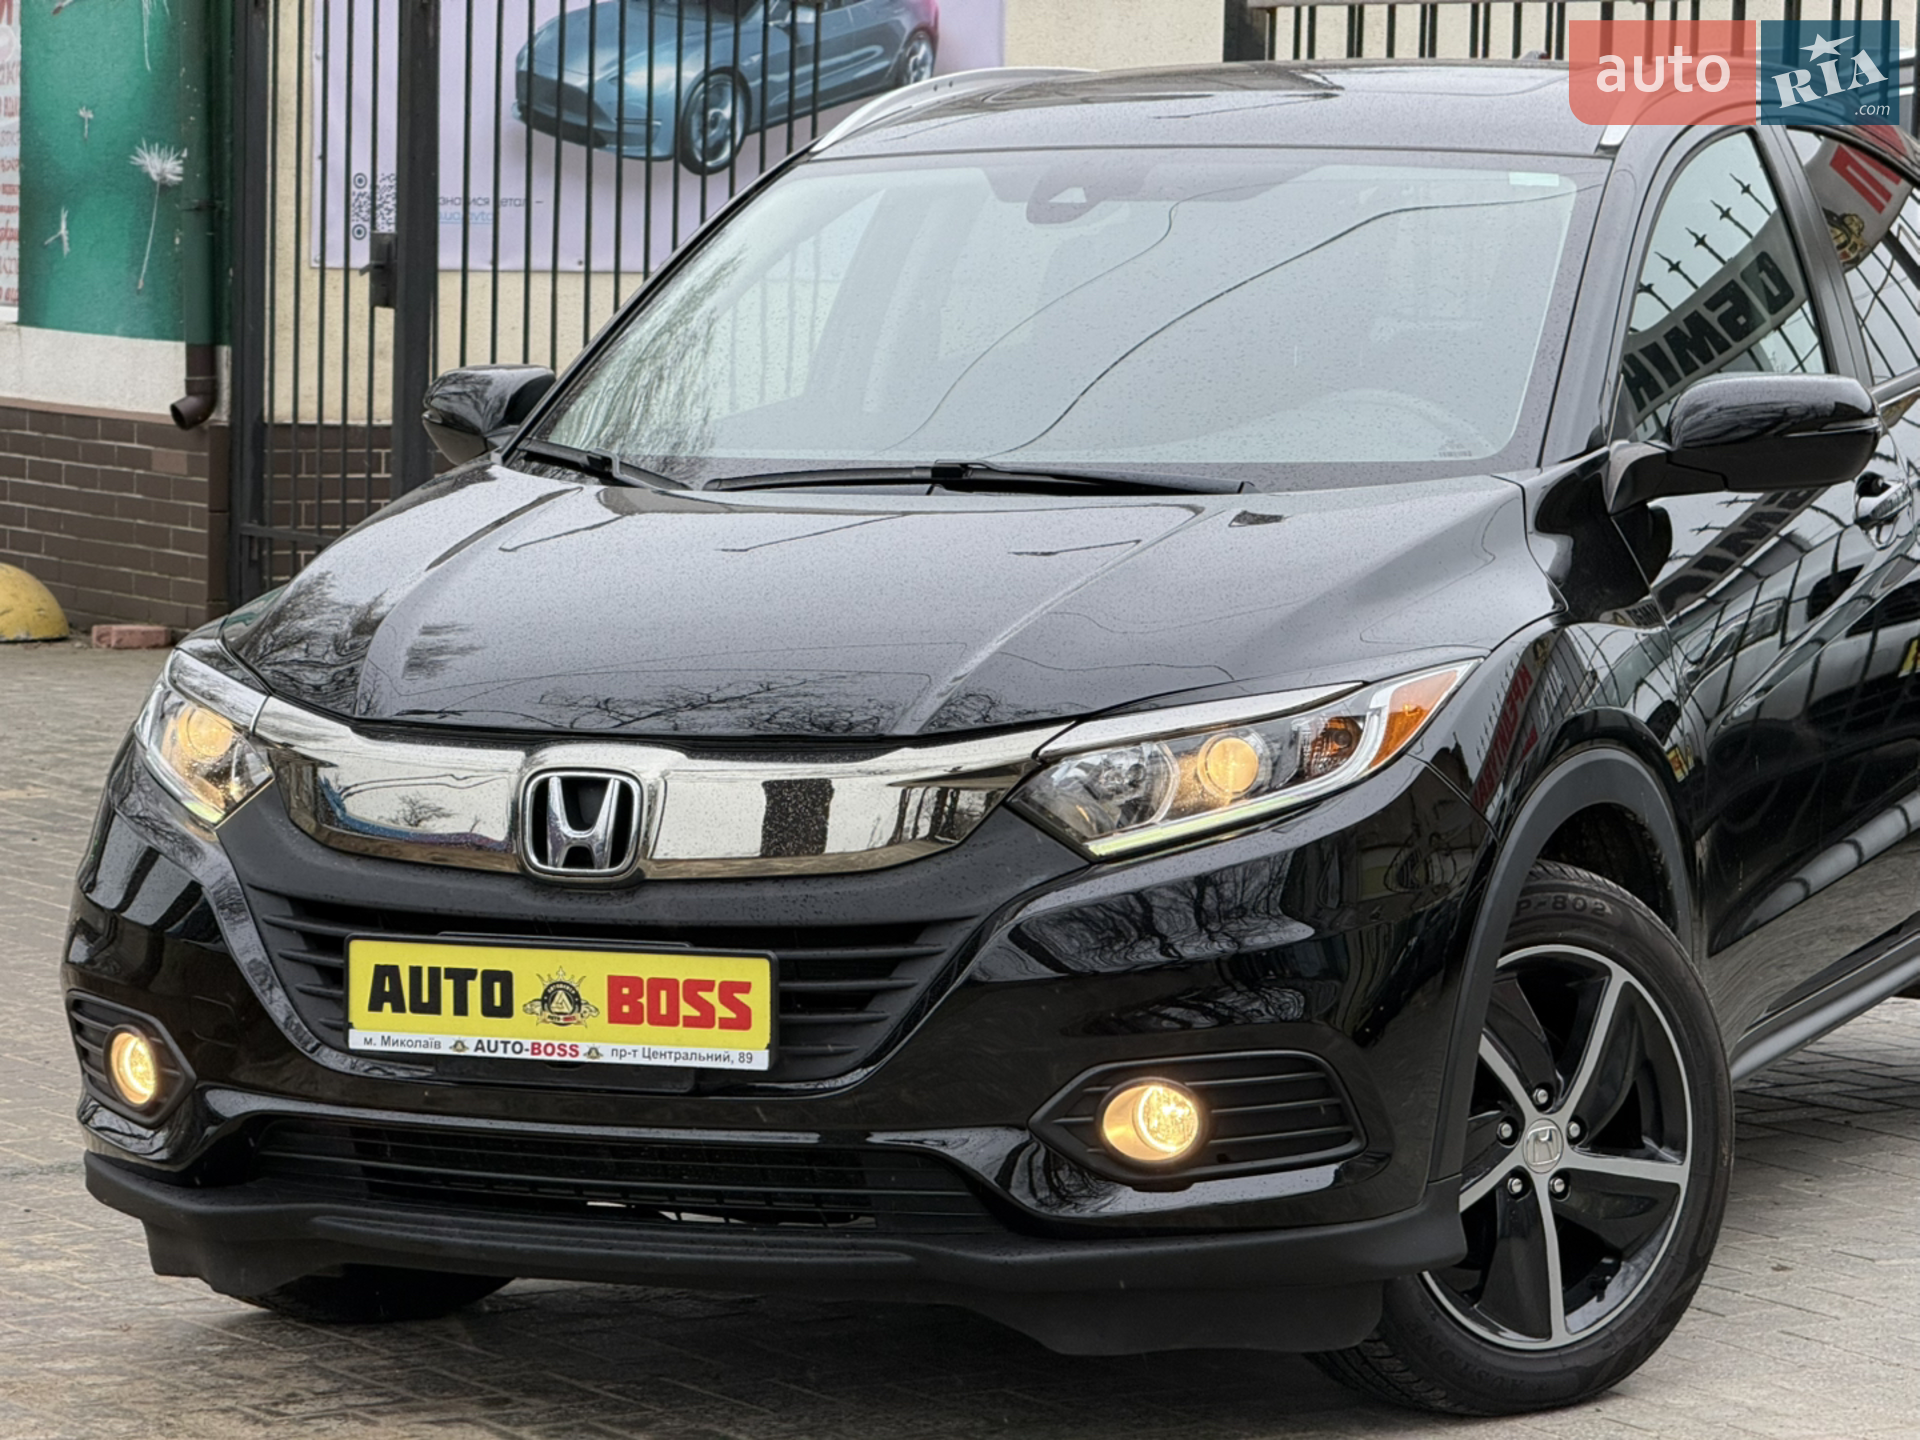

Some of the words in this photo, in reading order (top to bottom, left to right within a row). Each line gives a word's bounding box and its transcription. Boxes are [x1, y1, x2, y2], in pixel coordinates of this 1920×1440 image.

[368, 964, 514, 1018] AUTO
[607, 974, 753, 1031] BOSS
[363, 1036, 377, 1046] м.
[380, 1035, 442, 1050] Миколаїв
[474, 1039, 580, 1058] AUTO-BOSS
[611, 1047, 638, 1061] пр-т
[642, 1047, 735, 1065] Центральний,
[738, 1052, 754, 1064] 89
